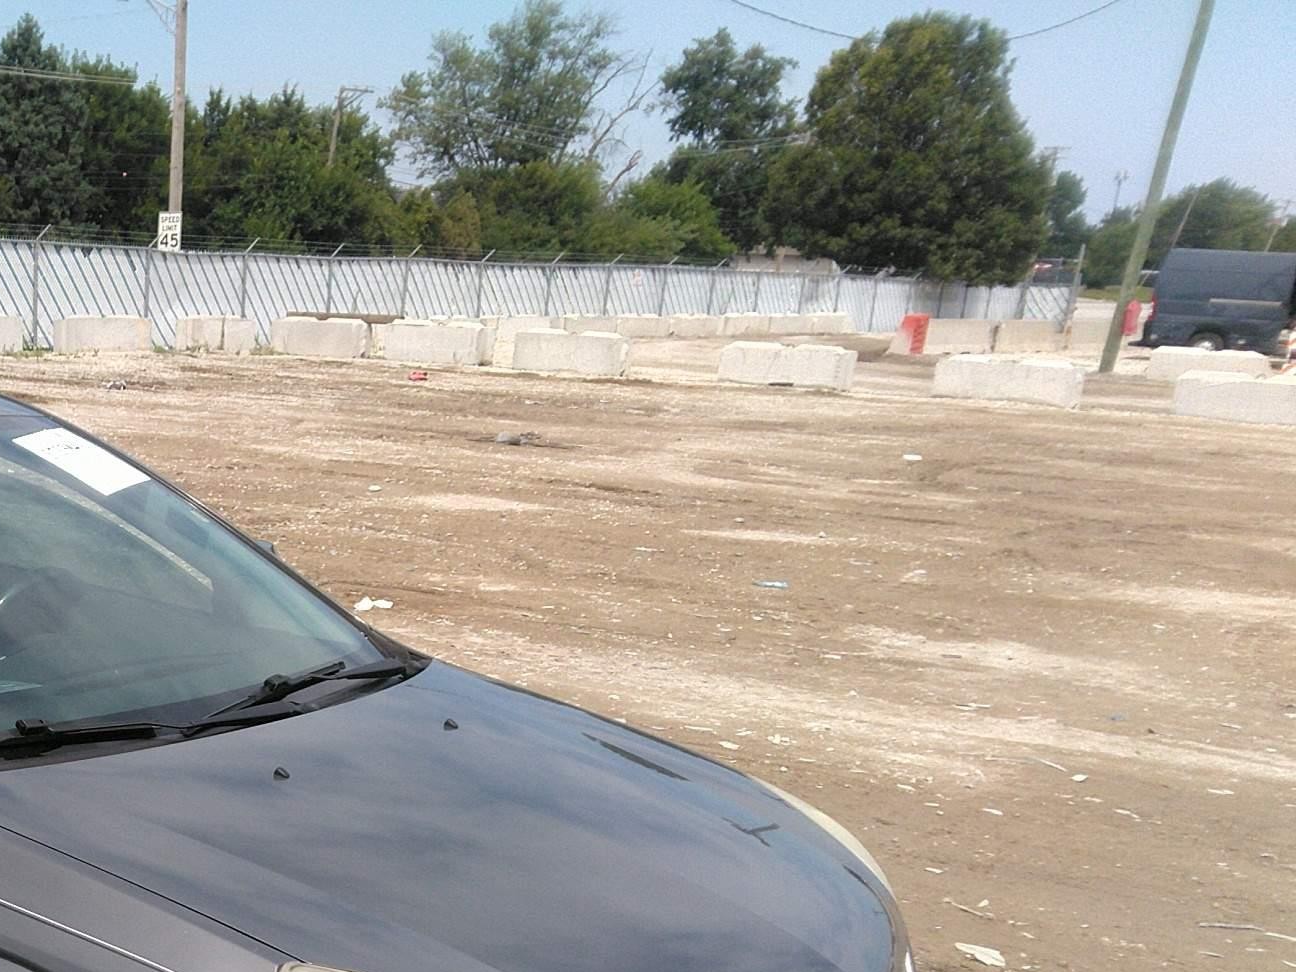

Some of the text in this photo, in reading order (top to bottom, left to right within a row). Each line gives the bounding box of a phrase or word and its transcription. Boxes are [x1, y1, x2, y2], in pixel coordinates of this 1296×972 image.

[161, 215, 180, 224] SPEED
[162, 224, 178, 232] LIMIT
[160, 233, 179, 248] 45
